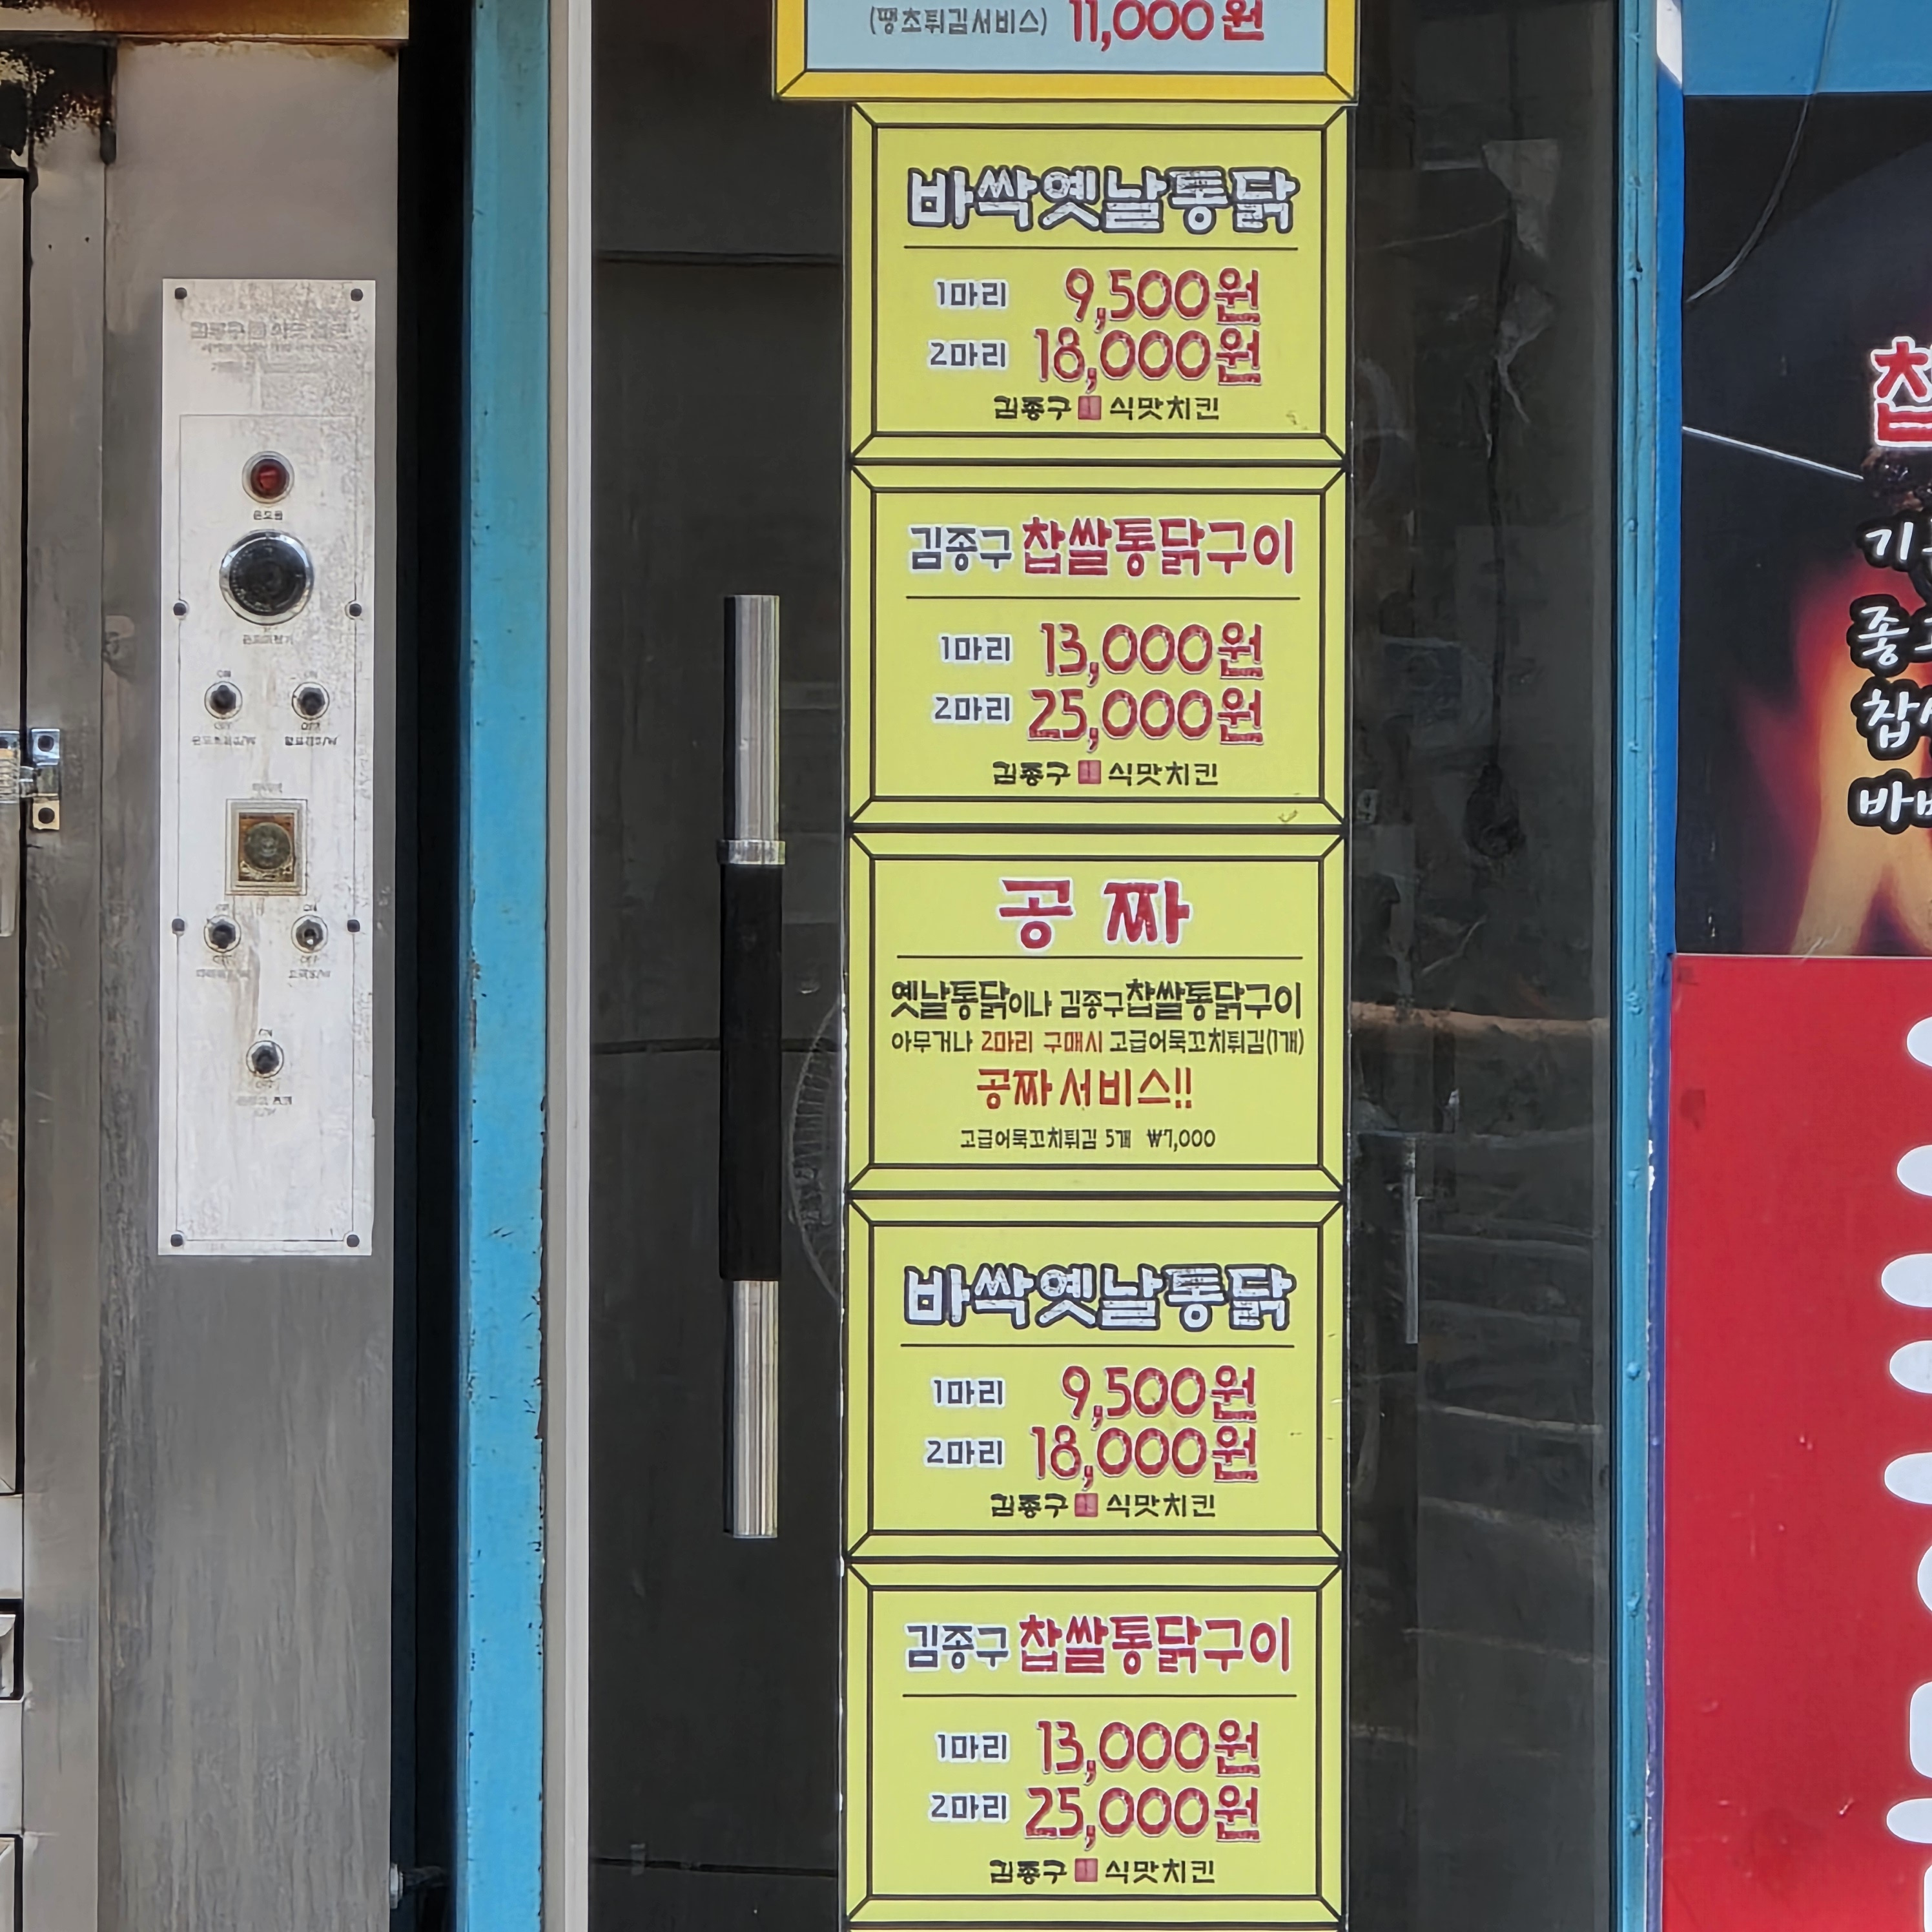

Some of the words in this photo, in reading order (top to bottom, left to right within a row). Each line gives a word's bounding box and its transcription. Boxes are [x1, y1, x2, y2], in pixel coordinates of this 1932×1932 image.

[1068, 0, 1265, 52] 11,000원
[907, 166, 1300, 234] 바싹옛날통닭
[936, 280, 1007, 308] 1마리
[1064, 267, 1261, 332] 9,500원
[929, 340, 1007, 367] 2마리
[1033, 326, 1262, 393] 18,000원
[994, 395, 1072, 421] 김종구
[1109, 395, 1220, 420] 식맛치킨
[910, 526, 1012, 571] 김종구
[1022, 516, 1293, 577] 찹쌀통닭구이
[1865, 521, 1932, 560] 기
[940, 635, 1010, 663] 1마리
[1040, 621, 1264, 687] 13,000원
[1858, 606, 1932, 666] 좋
[934, 695, 1010, 722] 2마리
[1027, 686, 1264, 753] 25,000원
[992, 761, 1071, 786] 김종구
[1108, 761, 1219, 786] 식맛치킨
[891, 980, 1052, 1020] 옛날통닭이나
[892, 1030, 973, 1053] 아무거나
[981, 1030, 1033, 1053] 2마리
[1043, 1030, 1103, 1053] 구매시
[960, 1127, 1097, 1150] 고급어묵꼬치튀김
[1105, 1129, 1131, 1149] 5개
[904, 1262, 1297, 1331] 바싹옛날통닭
[933, 1380, 1003, 1406] 1마리
[1062, 1365, 1257, 1431] 9,500원
[927, 1441, 1003, 1465] 2마리
[1031, 1424, 1259, 1491] 18,000원
[991, 1494, 1069, 1519] 김종구
[1106, 1494, 1216, 1519] 식맛치킨
[906, 1623, 1009, 1669] 김종구
[1018, 1614, 1290, 1674] 찹쌀통닭구이
[936, 1733, 1006, 1761] 1마리
[1036, 1719, 1260, 1785] 13,000원
[930, 1793, 1006, 1820] 2마리
[1023, 1784, 1260, 1851] 25,000원
[989, 1858, 1067, 1884] 김종구
[1104, 1859, 1215, 1884] 식맛치킨
